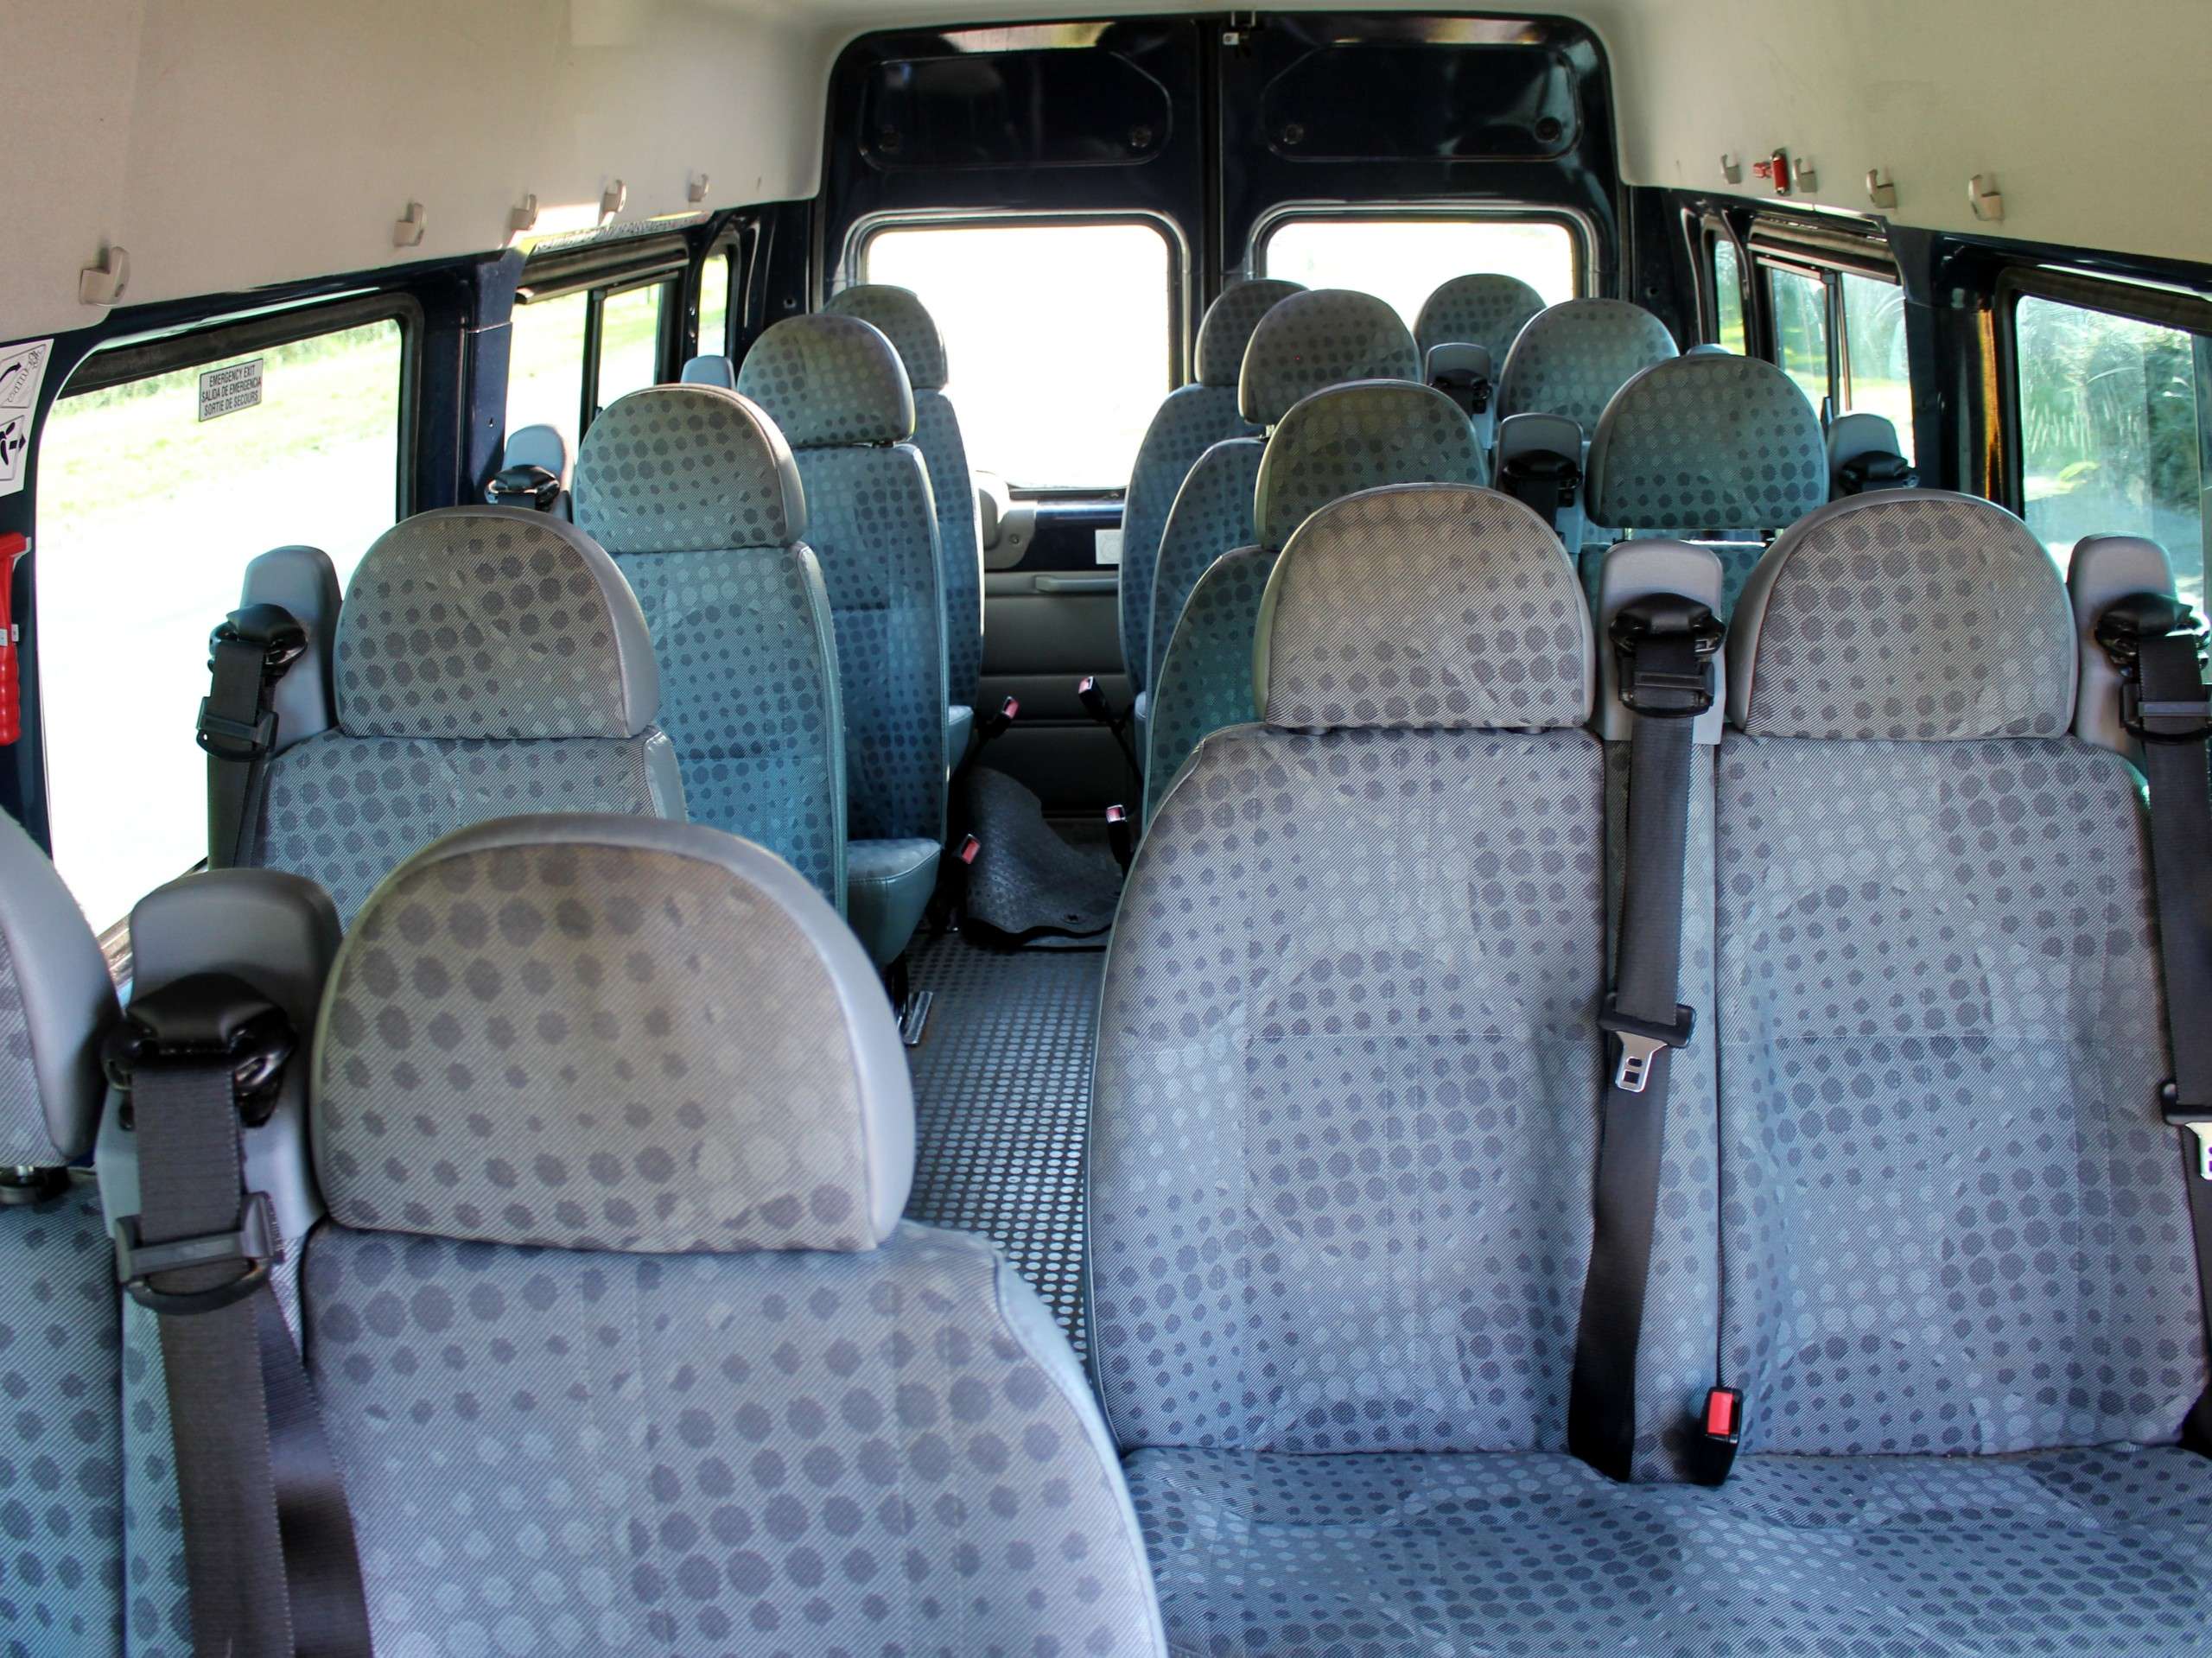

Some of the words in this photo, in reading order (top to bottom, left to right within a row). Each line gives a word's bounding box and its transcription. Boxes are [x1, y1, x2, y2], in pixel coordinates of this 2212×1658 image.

[209, 369, 242, 387] EMERGENCY
[244, 365, 255, 378] EXIT
[201, 387, 220, 403] SALIDA
[221, 385, 228, 397] DE
[204, 400, 224, 416] SORTIE
[226, 397, 232, 410] DE
[234, 391, 258, 407] SECOURS
